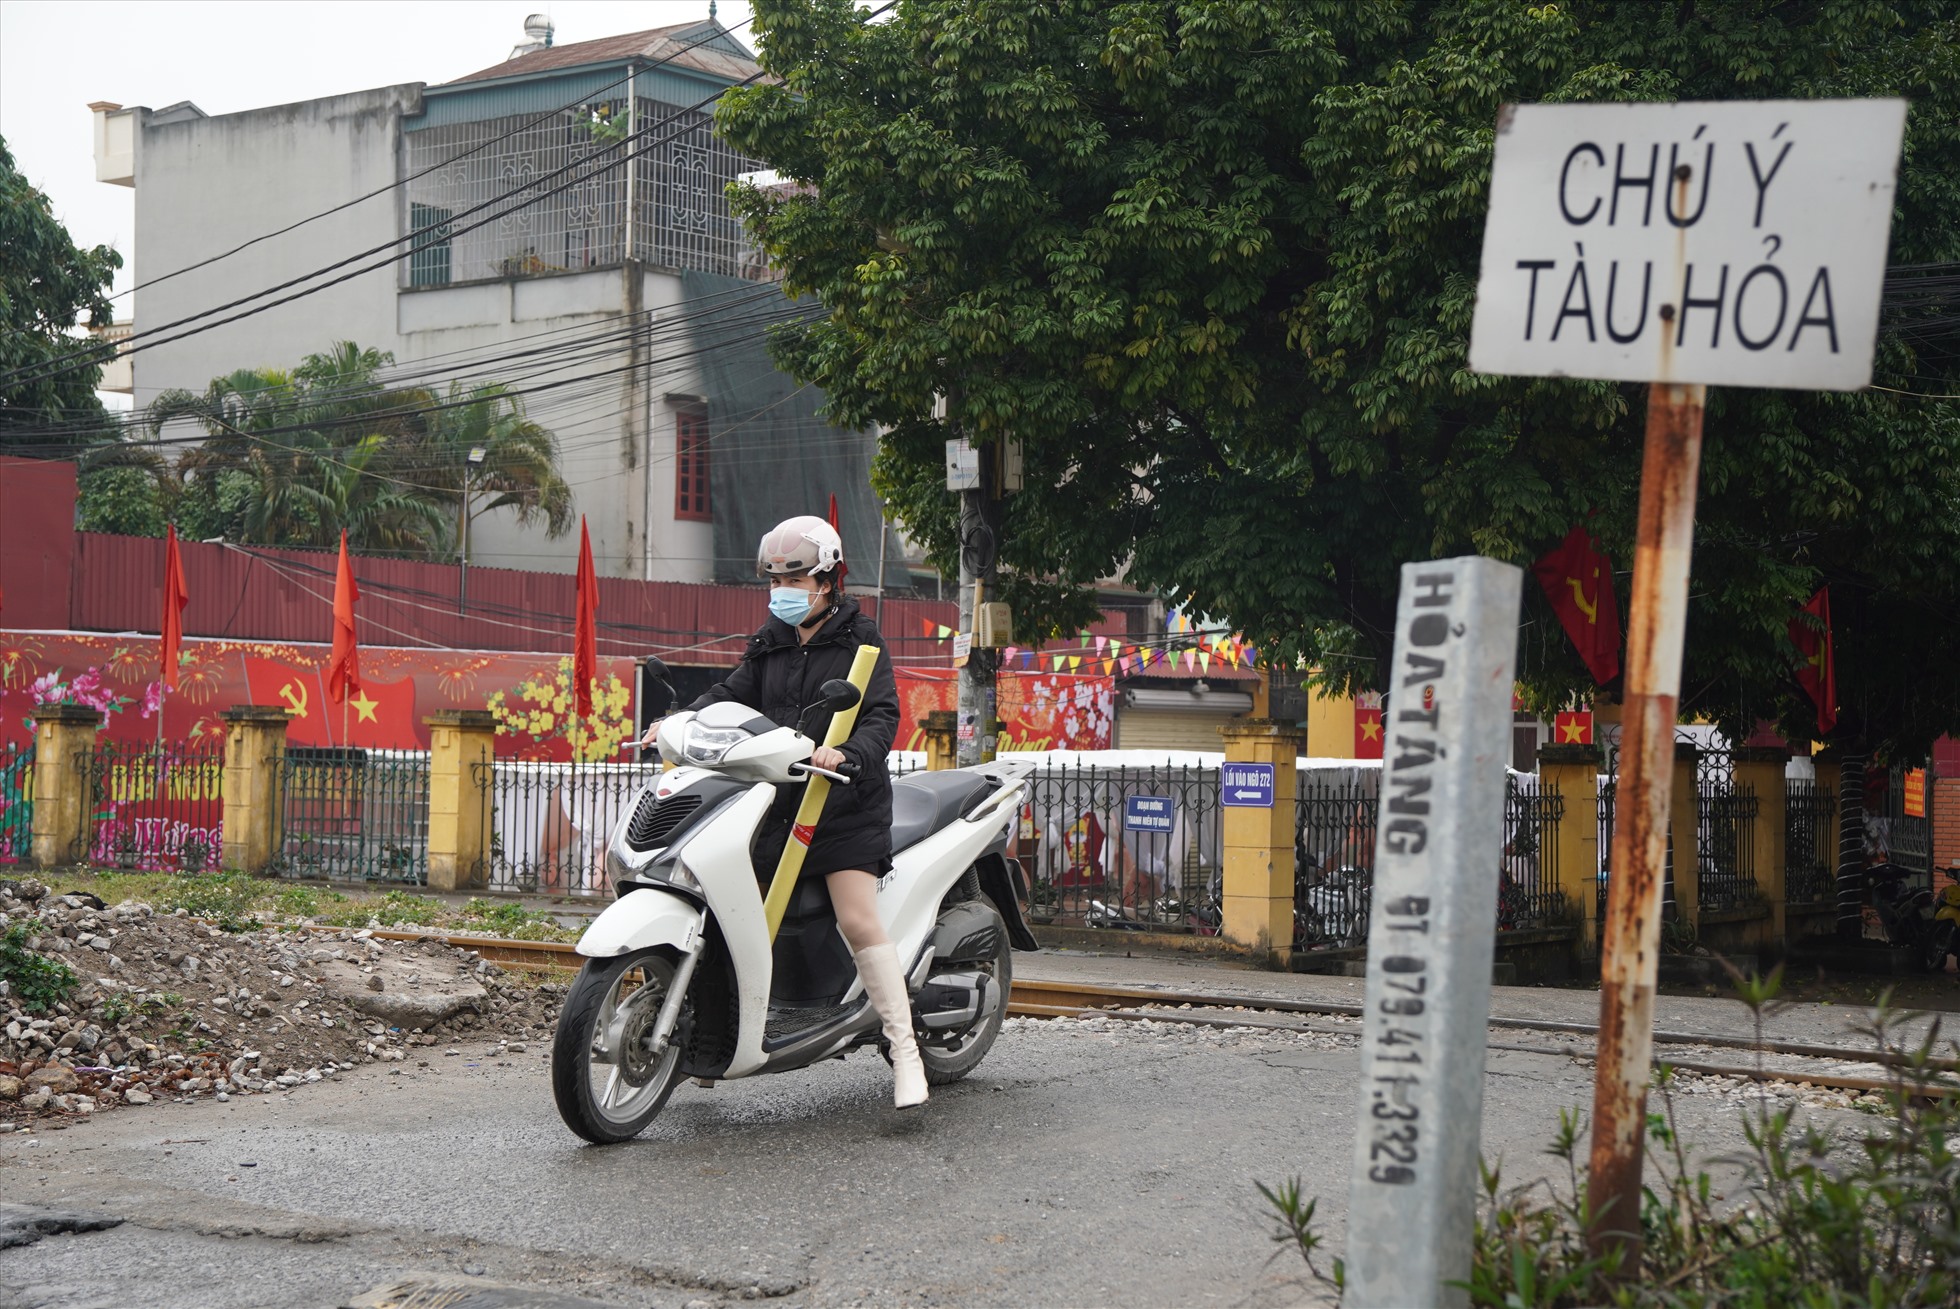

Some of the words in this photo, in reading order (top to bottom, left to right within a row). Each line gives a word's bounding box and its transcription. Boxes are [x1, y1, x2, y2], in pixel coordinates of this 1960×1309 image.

[1559, 124, 1715, 229] CHÚ
[1743, 122, 1795, 229] Ý
[1515, 241, 1653, 345] TÀU
[1675, 234, 1840, 354] HỎA
[1403, 572, 1466, 688] HỎA
[168, 754, 225, 801] NƯỚ
[1225, 767, 1235, 787] LỐI
[1235, 769, 1247, 787] VÀO
[1247, 769, 1259, 788] NGÕ
[1260, 773, 1271, 788] 272
[1384, 702, 1447, 855] TÁNG
